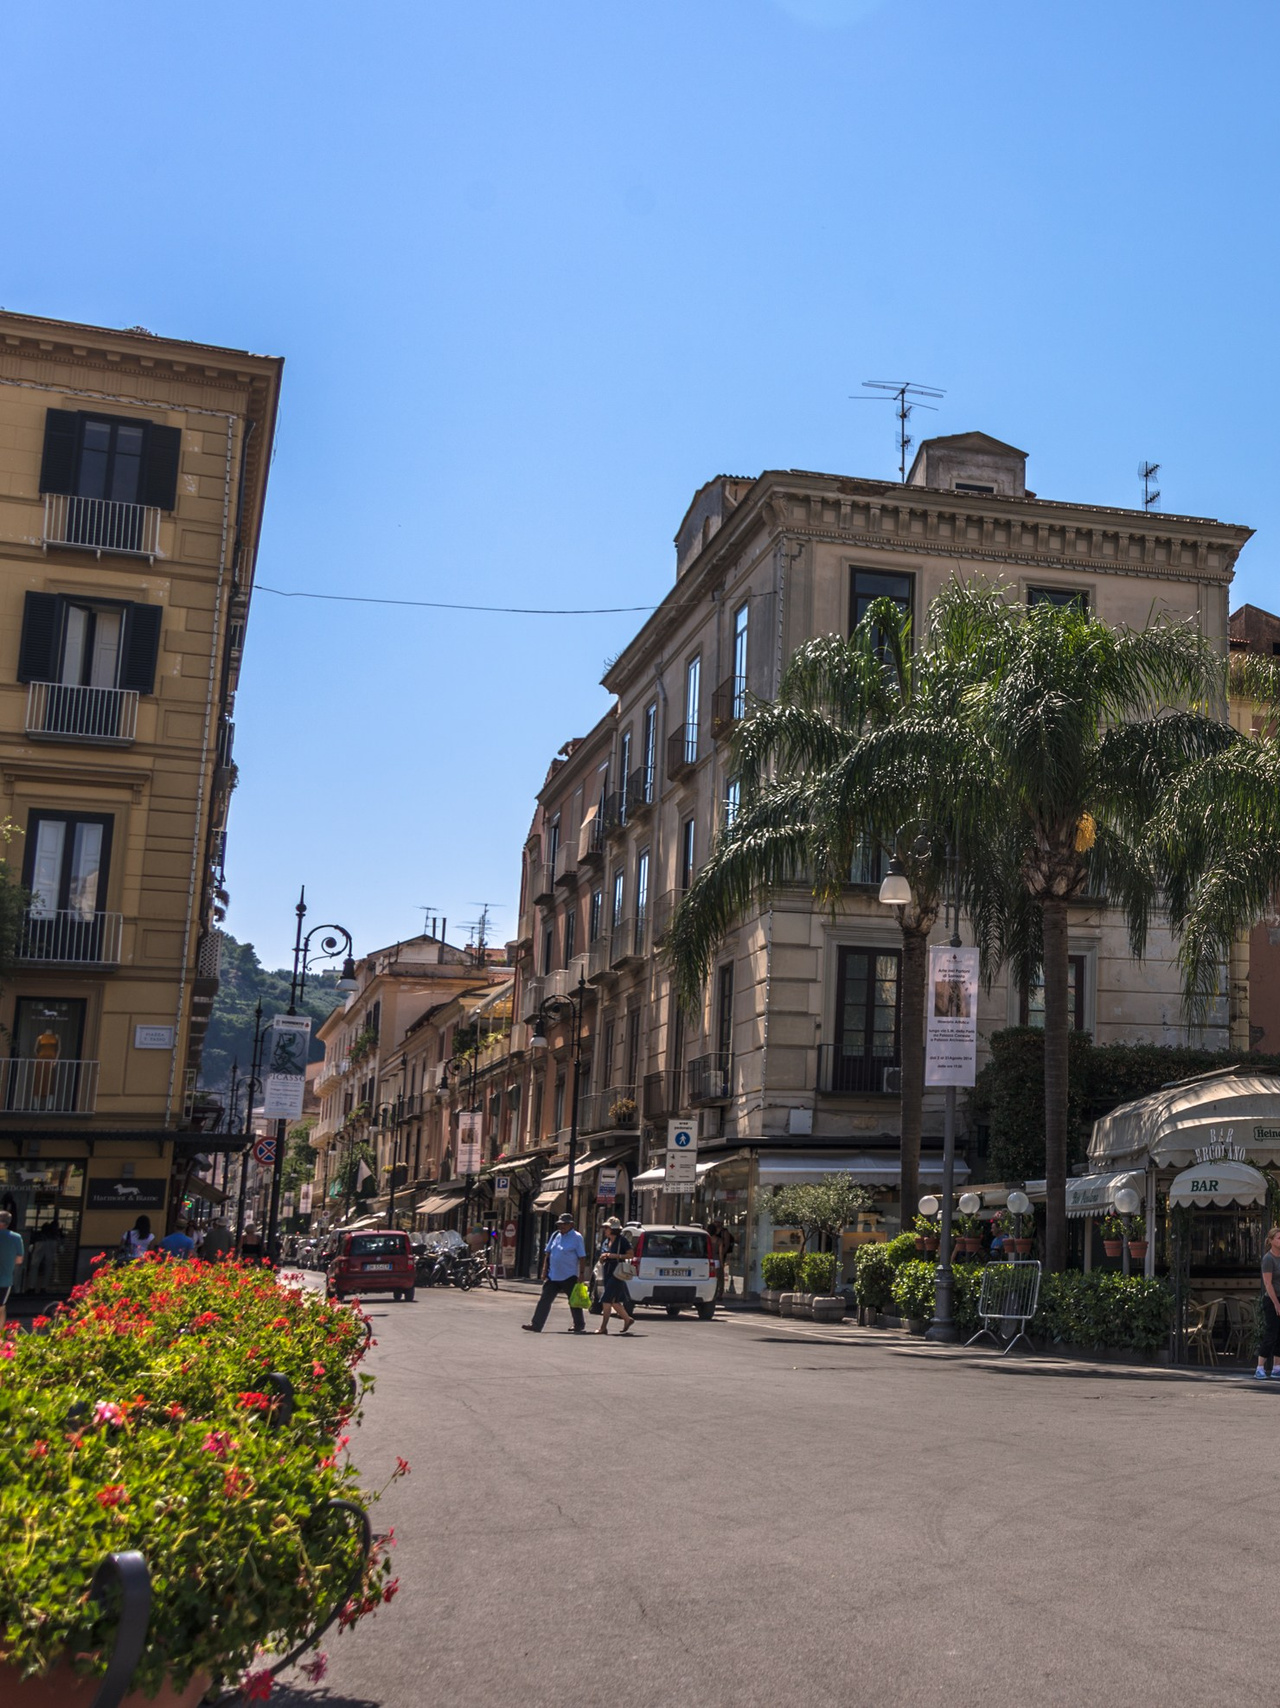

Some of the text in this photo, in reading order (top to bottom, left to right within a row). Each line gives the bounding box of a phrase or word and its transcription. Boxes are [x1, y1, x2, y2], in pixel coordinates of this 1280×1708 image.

[1210, 1128, 1234, 1143] BAR
[1195, 1145, 1246, 1163] ERCOLANO
[1190, 1180, 1219, 1192] BAR
